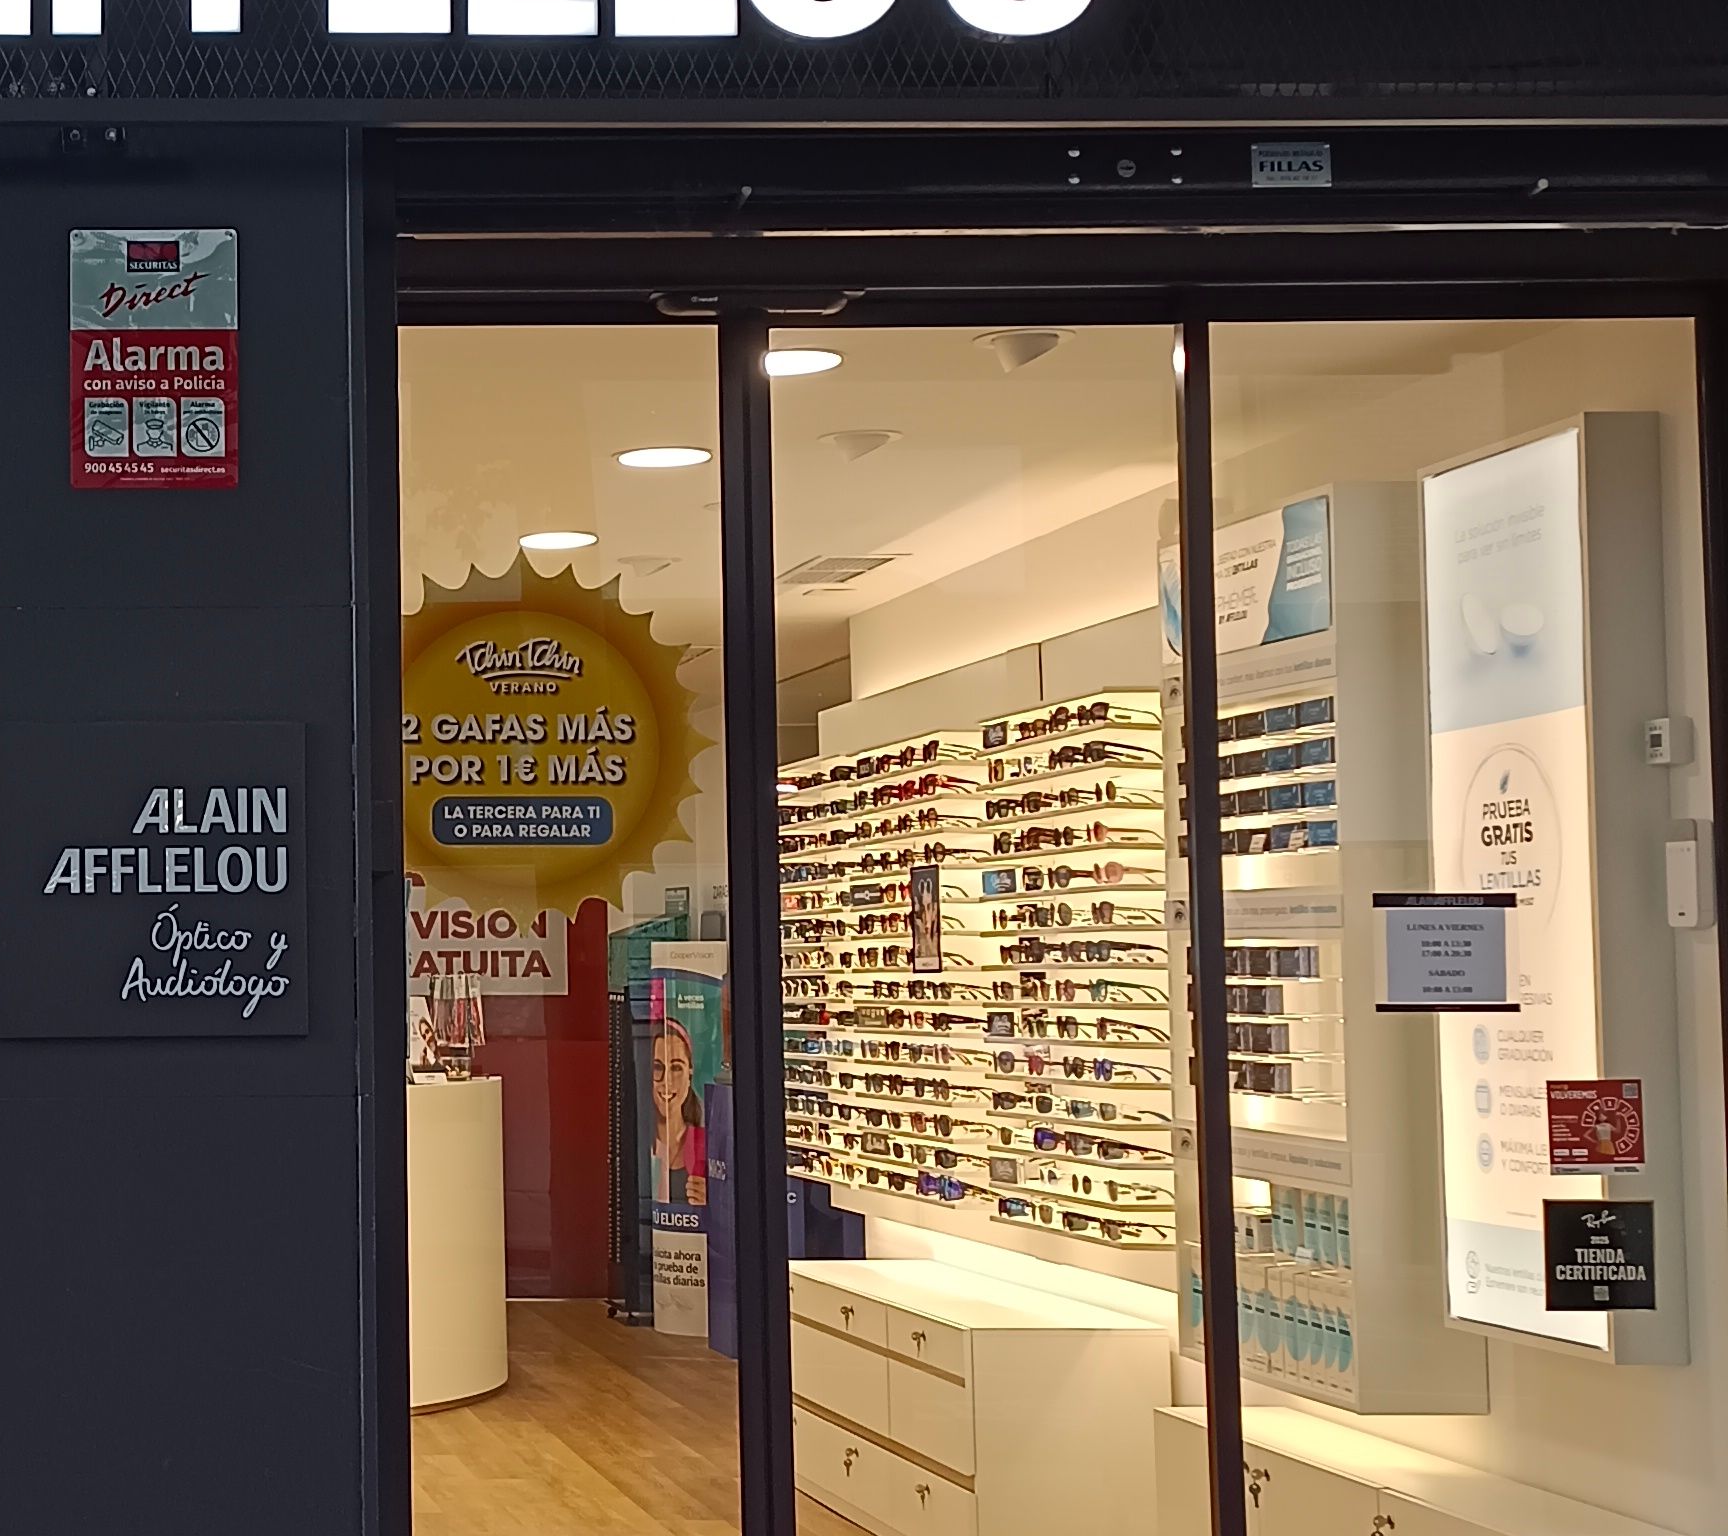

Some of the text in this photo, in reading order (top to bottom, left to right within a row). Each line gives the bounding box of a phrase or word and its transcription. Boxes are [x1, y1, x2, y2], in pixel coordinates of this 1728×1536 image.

[1259, 160, 1324, 172] FILLAS
[129, 261, 178, 270] SECURITAS
[98, 271, 212, 318] Direct
[83, 337, 225, 372] Alarma
[83, 375, 225, 391] con aviso a Policía
[84, 462, 154, 474] 900 45 45 45
[455, 636, 582, 674] Tchin Tchin
[489, 680, 558, 694] VERANO
[402, 705, 636, 743] 2 GAFAS MÁS
[409, 746, 625, 783] POR 1€ MÁS
[132, 787, 288, 834] ALAIN
[443, 805, 601, 820] LA TERCERA PARA TI
[1481, 798, 1531, 820] PRUEBA
[453, 824, 592, 838] O PARA REGALAR
[1480, 821, 1534, 847] GRATIS
[1500, 850, 1518, 866] TUS
[43, 846, 288, 894] AFFLELOU
[1479, 869, 1541, 891] LENTILLAS
[151, 902, 289, 971] Óptico y
[121, 956, 291, 1019] Audiólogo
[677, 993, 682, 1001] A
[660, 1212, 700, 1228] ELIGES
[673, 1250, 702, 1262] ahora
[1573, 1248, 1626, 1264] TIENDA
[685, 1263, 699, 1275] de
[1554, 1264, 1647, 1281] CERTIFICADA
